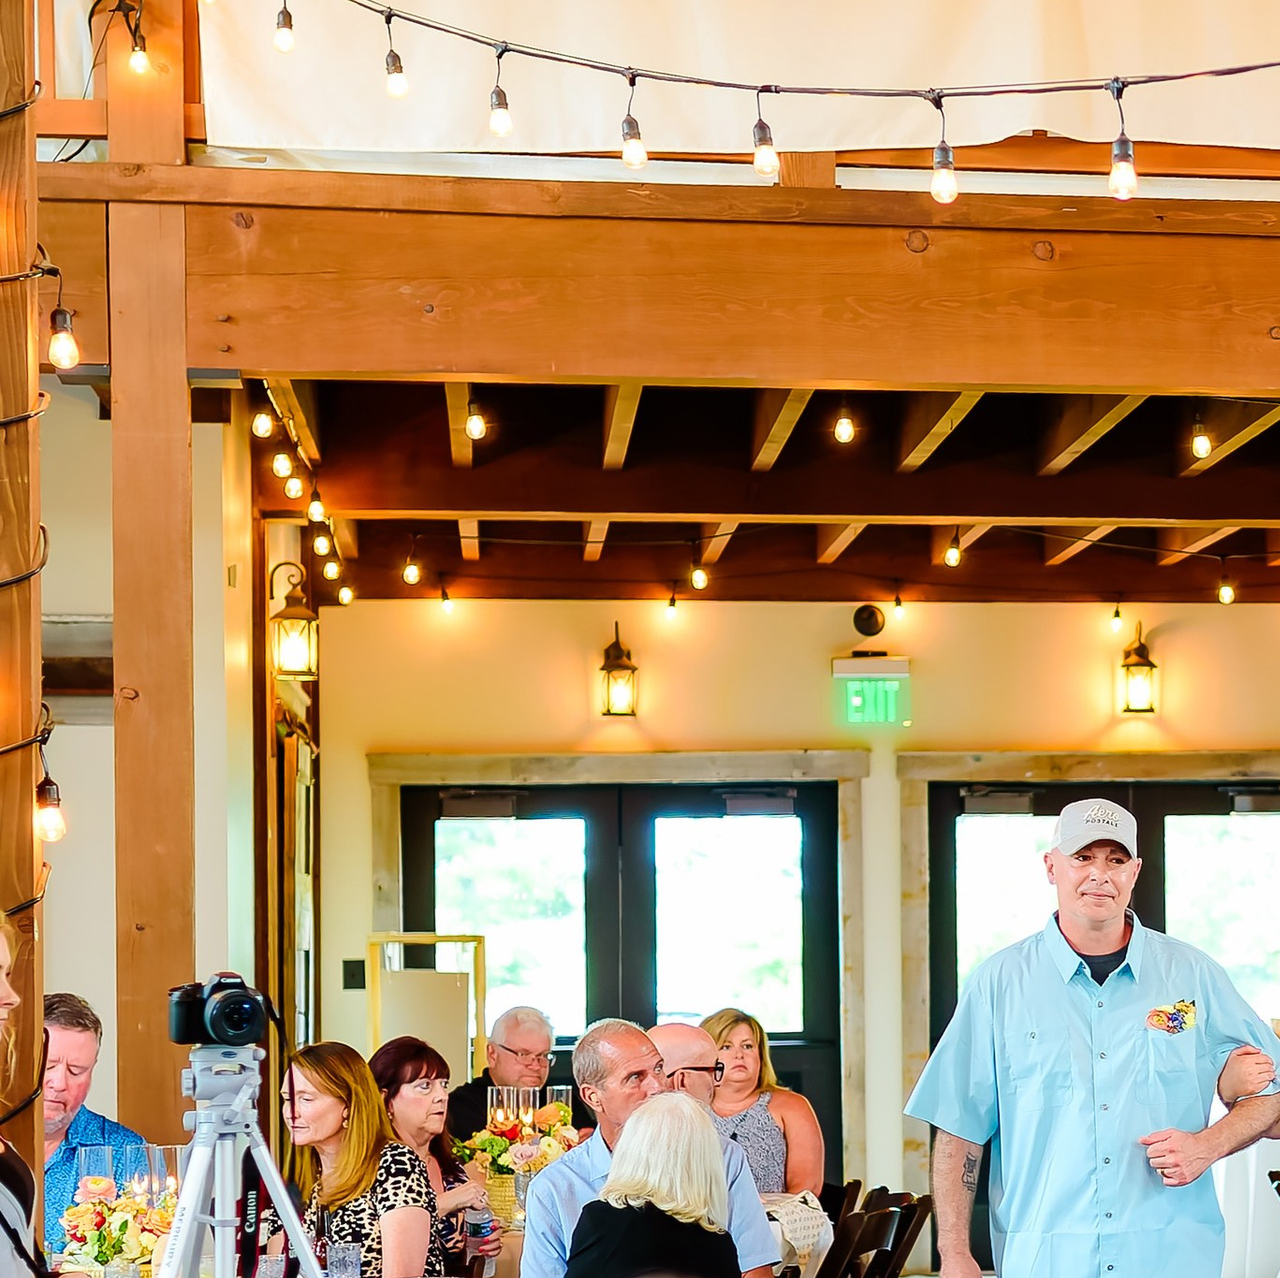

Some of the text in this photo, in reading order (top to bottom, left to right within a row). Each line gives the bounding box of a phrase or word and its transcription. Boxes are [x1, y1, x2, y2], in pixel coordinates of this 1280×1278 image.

[847, 680, 900, 723] EXIT
[1082, 805, 1120, 821] Aero
[244, 1190, 257, 1233] Canon
